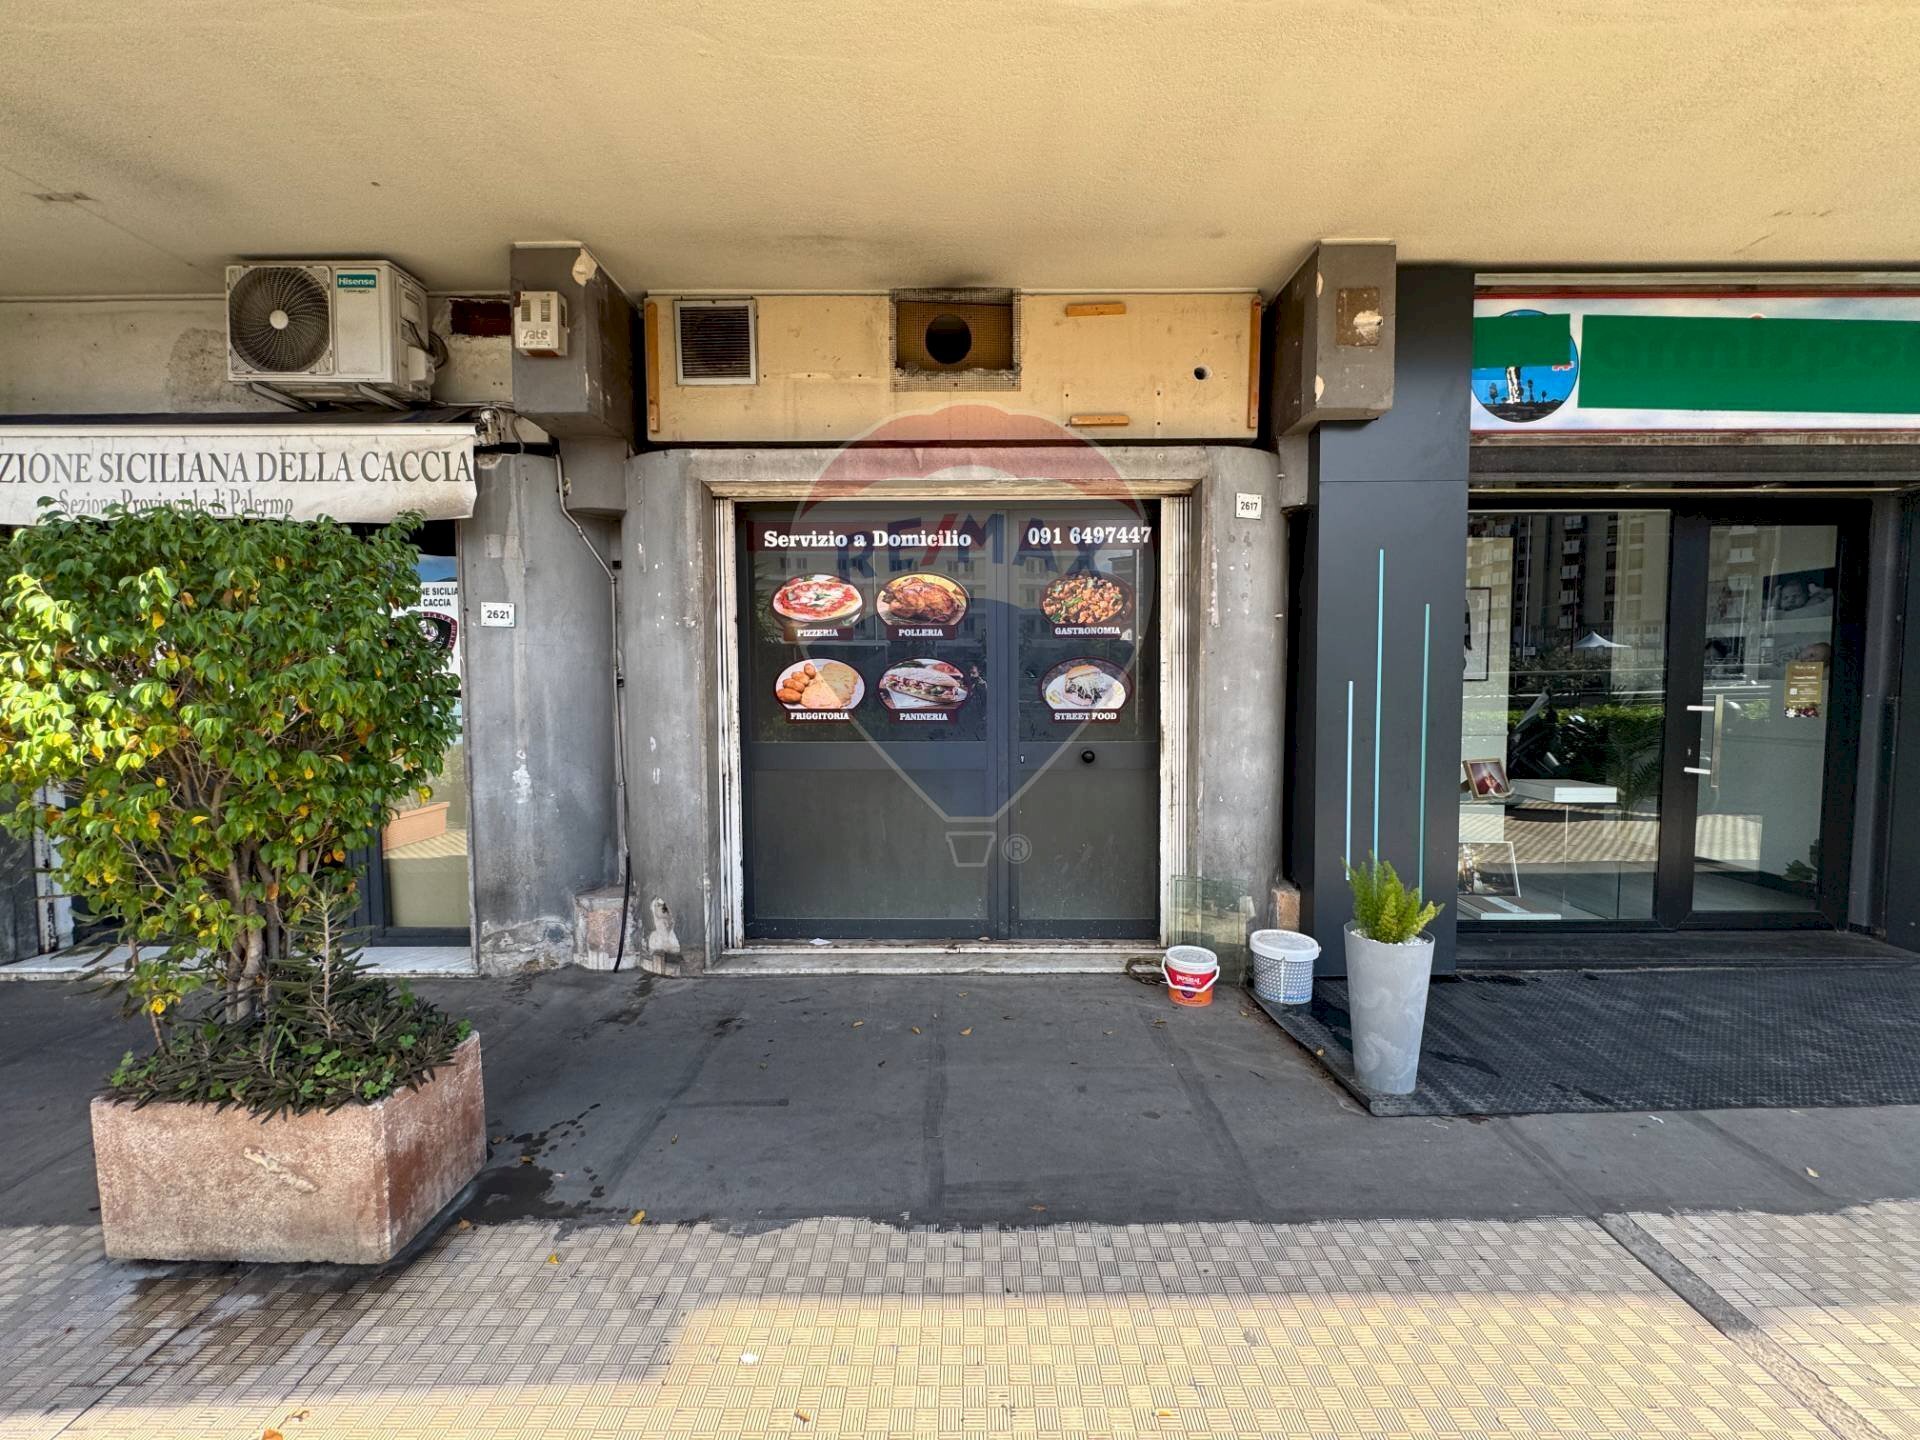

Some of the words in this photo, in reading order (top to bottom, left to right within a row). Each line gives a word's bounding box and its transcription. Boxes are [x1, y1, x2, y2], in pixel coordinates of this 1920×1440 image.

[338, 277, 375, 286] Hisense
[99, 452, 250, 483] SICILIANA
[256, 451, 355, 482] DELLA
[360, 450, 474, 482] CACCIA
[229, 488, 294, 515] Palermo
[1240, 501, 1258, 511] 2617
[764, 530, 848, 548] Servizio
[853, 534, 867, 547] a
[872, 530, 972, 548] Domicilio
[1028, 527, 1062, 545] 091
[1069, 526, 1152, 545] 6497447
[423, 598, 452, 607] CACCIA
[486, 610, 510, 620] 2621
[797, 629, 839, 637] PIZZERIA
[898, 629, 943, 637] POLLERIA
[1054, 627, 1121, 635] GASTRONOMIA
[790, 712, 850, 720] FRIGGITORIA
[899, 712, 948, 721] PANINERIA
[1054, 712, 1090, 720] STREET
[1091, 712, 1117, 720] FOOD
